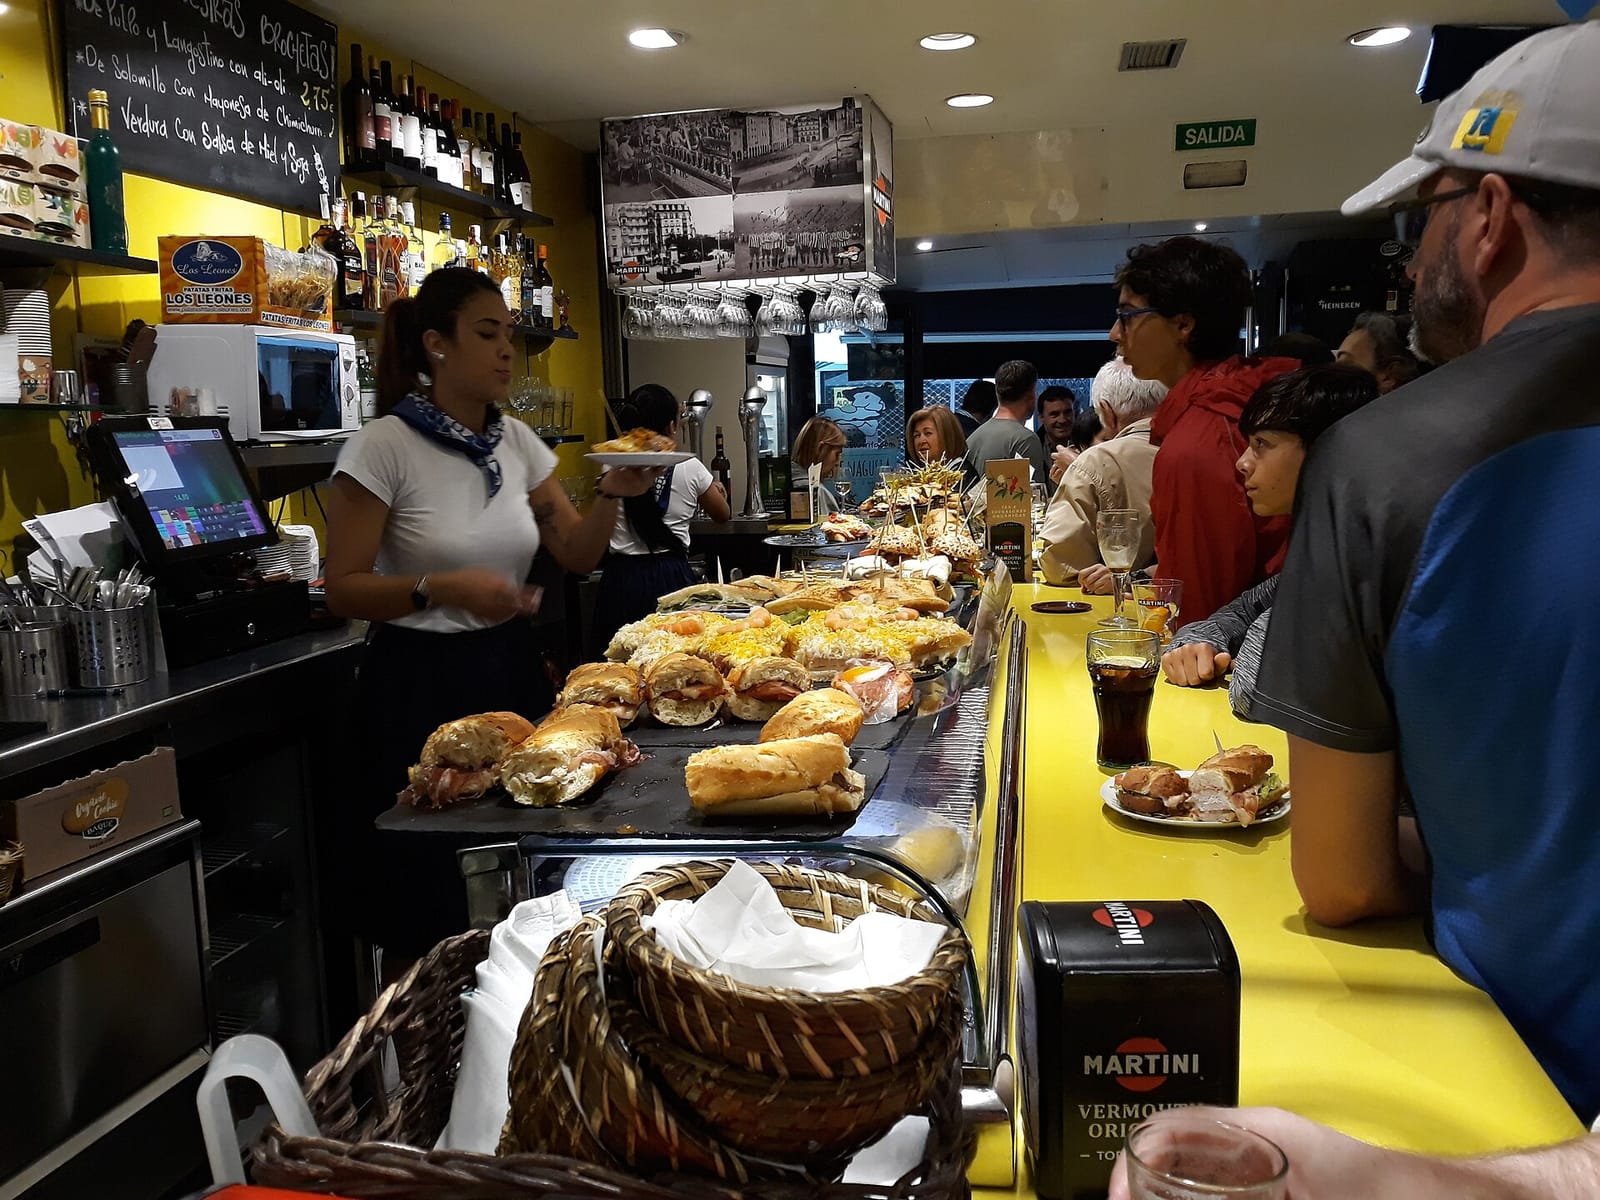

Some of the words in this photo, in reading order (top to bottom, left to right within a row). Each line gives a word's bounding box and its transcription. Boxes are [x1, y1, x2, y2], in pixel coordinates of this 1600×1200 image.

[146, 26, 158, 52] y
[163, 21, 224, 75] Langostino
[112, 53, 166, 94] Solomillo
[256, 95, 269, 122] de
[120, 97, 168, 138] Verdura
[201, 121, 236, 154] Salsa
[240, 129, 254, 155] de
[280, 151, 288, 175] y
[1185, 125, 1245, 145] SALIDA
[177, 263, 199, 275] Los
[616, 266, 648, 274] MARTINI
[166, 294, 193, 304] LOS
[197, 294, 251, 304] LEONES
[1321, 301, 1360, 310] HEINEKEN
[262, 312, 285, 323] PATATAS
[285, 316, 303, 326] FRITAS
[1103, 902, 1145, 945] MARTINI
[1083, 1054, 1199, 1075] MARTINI
